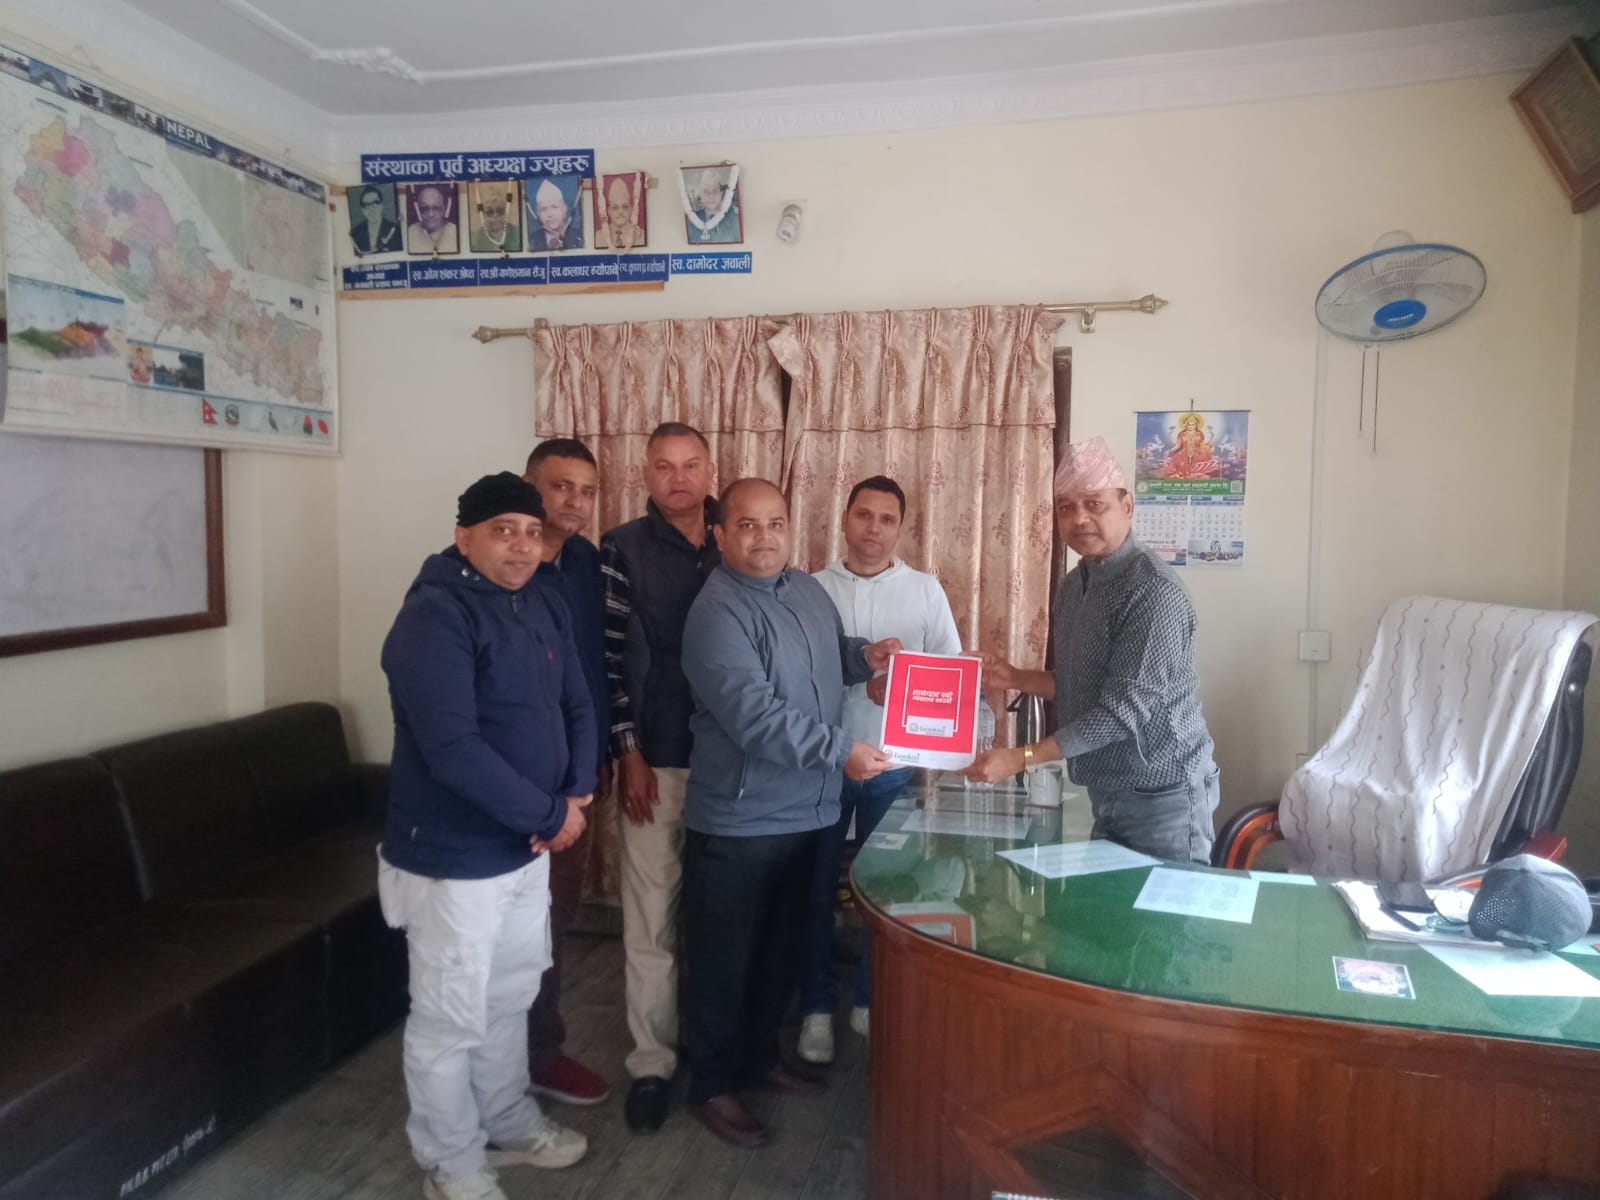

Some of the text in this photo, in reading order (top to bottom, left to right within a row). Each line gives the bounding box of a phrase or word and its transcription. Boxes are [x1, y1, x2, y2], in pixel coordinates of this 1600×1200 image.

[166, 119, 213, 150] NEPAL
[364, 157, 433, 177] संस्थाका
[439, 155, 463, 178] पूर्व
[468, 156, 526, 175] अध्यक्ष
[687, 256, 718, 271] दामोदर
[722, 255, 751, 270] ज्ञवाली
